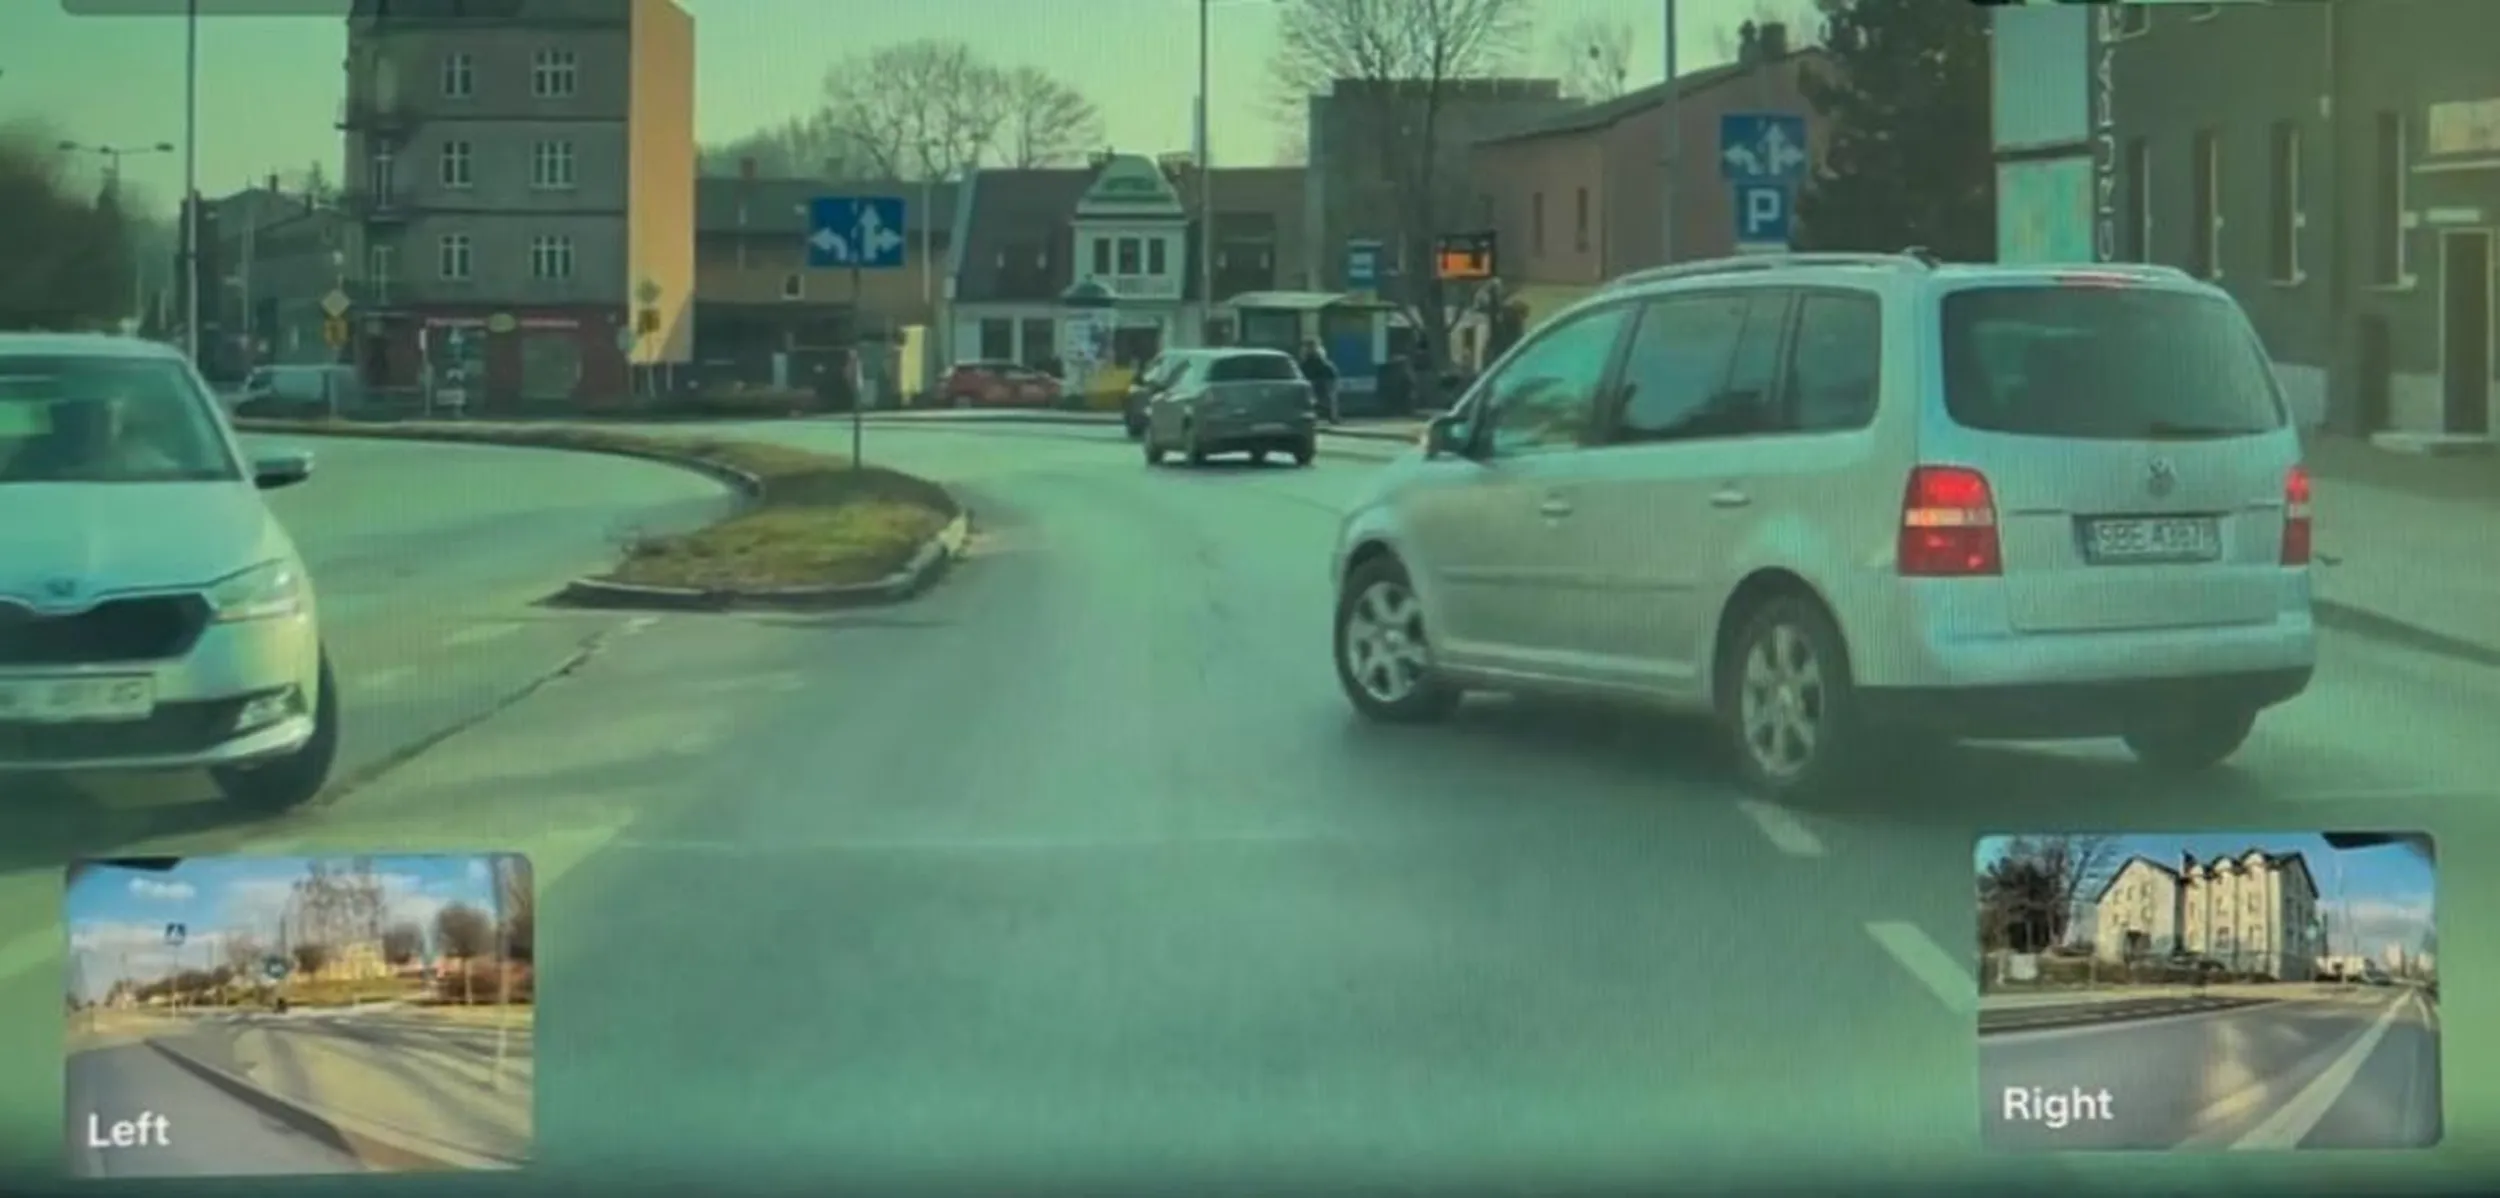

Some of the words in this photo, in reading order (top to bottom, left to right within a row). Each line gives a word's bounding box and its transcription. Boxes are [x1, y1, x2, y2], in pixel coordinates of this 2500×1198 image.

[1748, 189, 1780, 234] P
[87, 1110, 171, 1148] Left
[2003, 1085, 2114, 1129] Right
